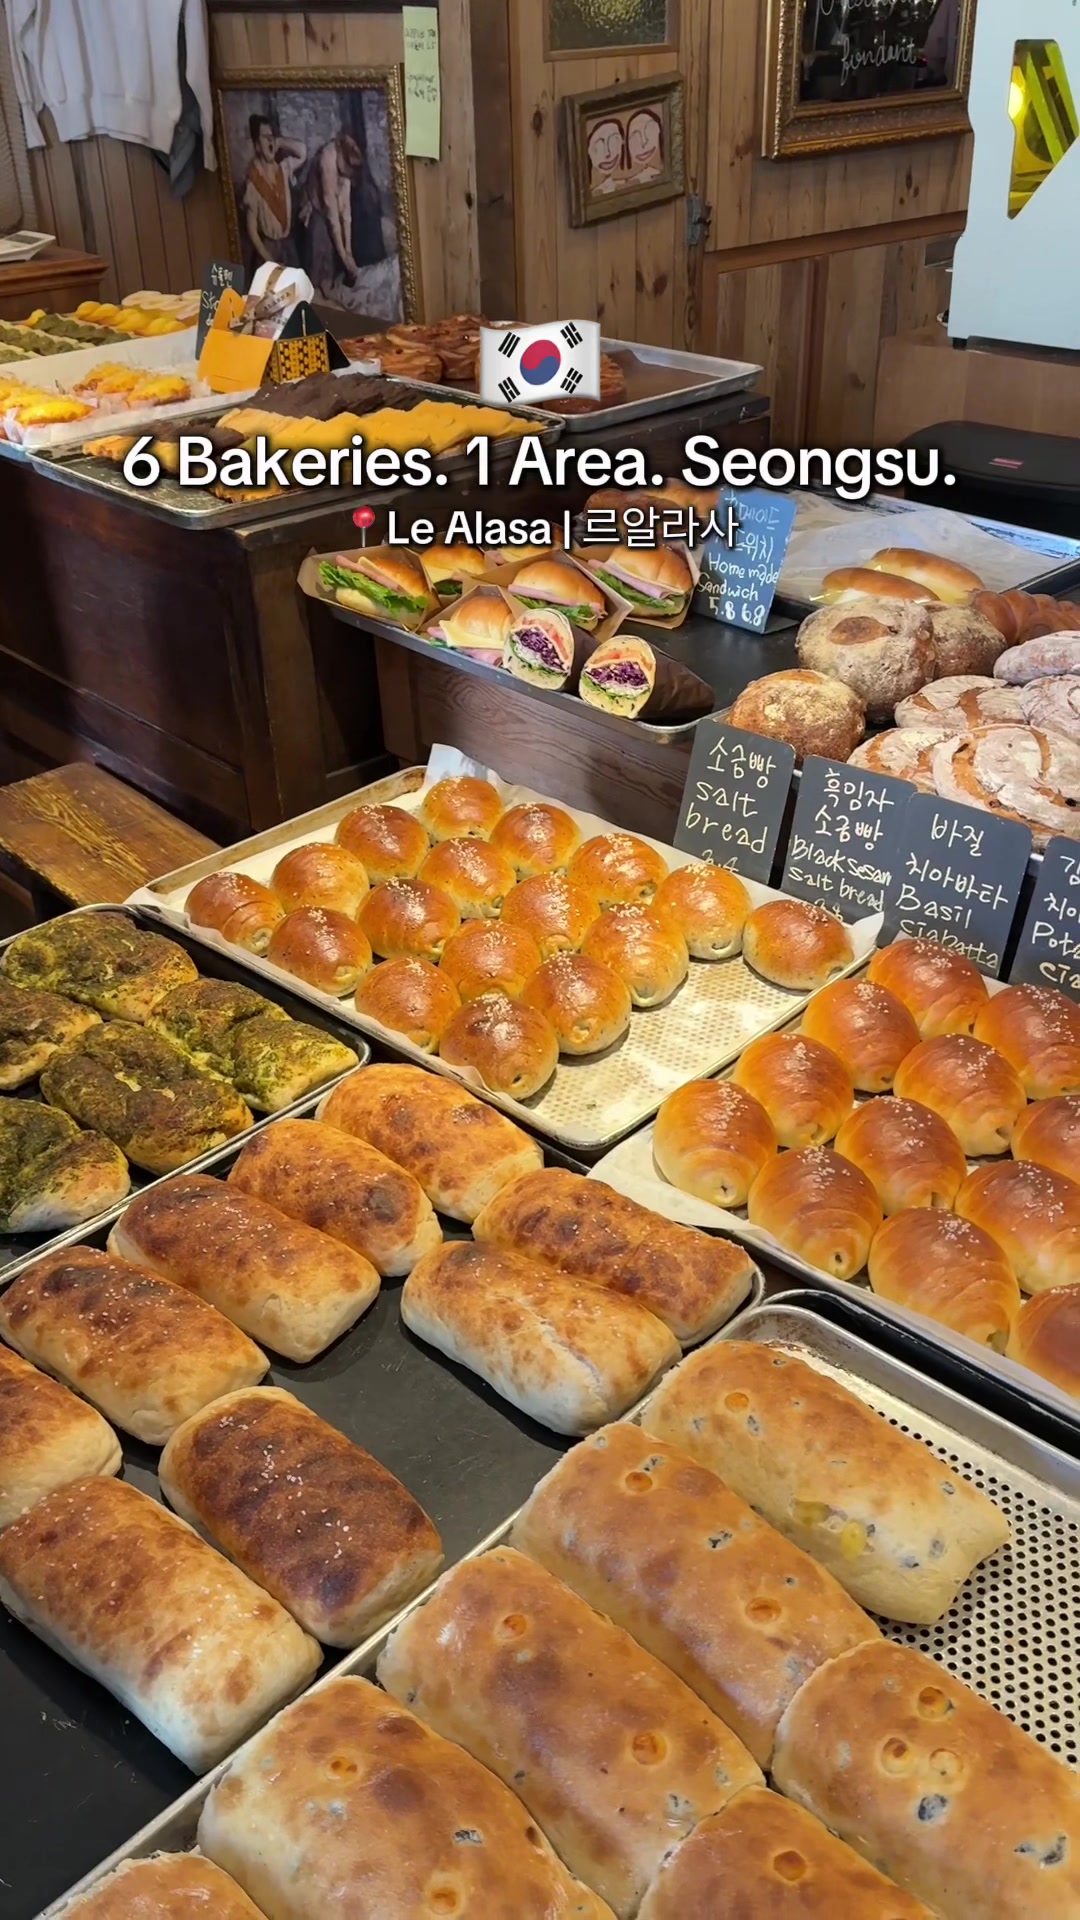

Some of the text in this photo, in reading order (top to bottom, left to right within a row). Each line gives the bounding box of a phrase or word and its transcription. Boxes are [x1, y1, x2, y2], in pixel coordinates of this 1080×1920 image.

[697, 572, 759, 602] Sandwich
[708, 552, 745, 579] Home
[708, 596, 736, 621] 5.8
[707, 736, 777, 789] 소금빵
[824, 767, 895, 813] 흑임자
[685, 802, 768, 854] bread
[815, 804, 884, 851] 소금빵
[931, 813, 985, 857] 바질
[791, 835, 847, 873] Black
[839, 877, 885, 912] bread
[905, 852, 1009, 911] 치아바타
[895, 883, 972, 929] Basil
